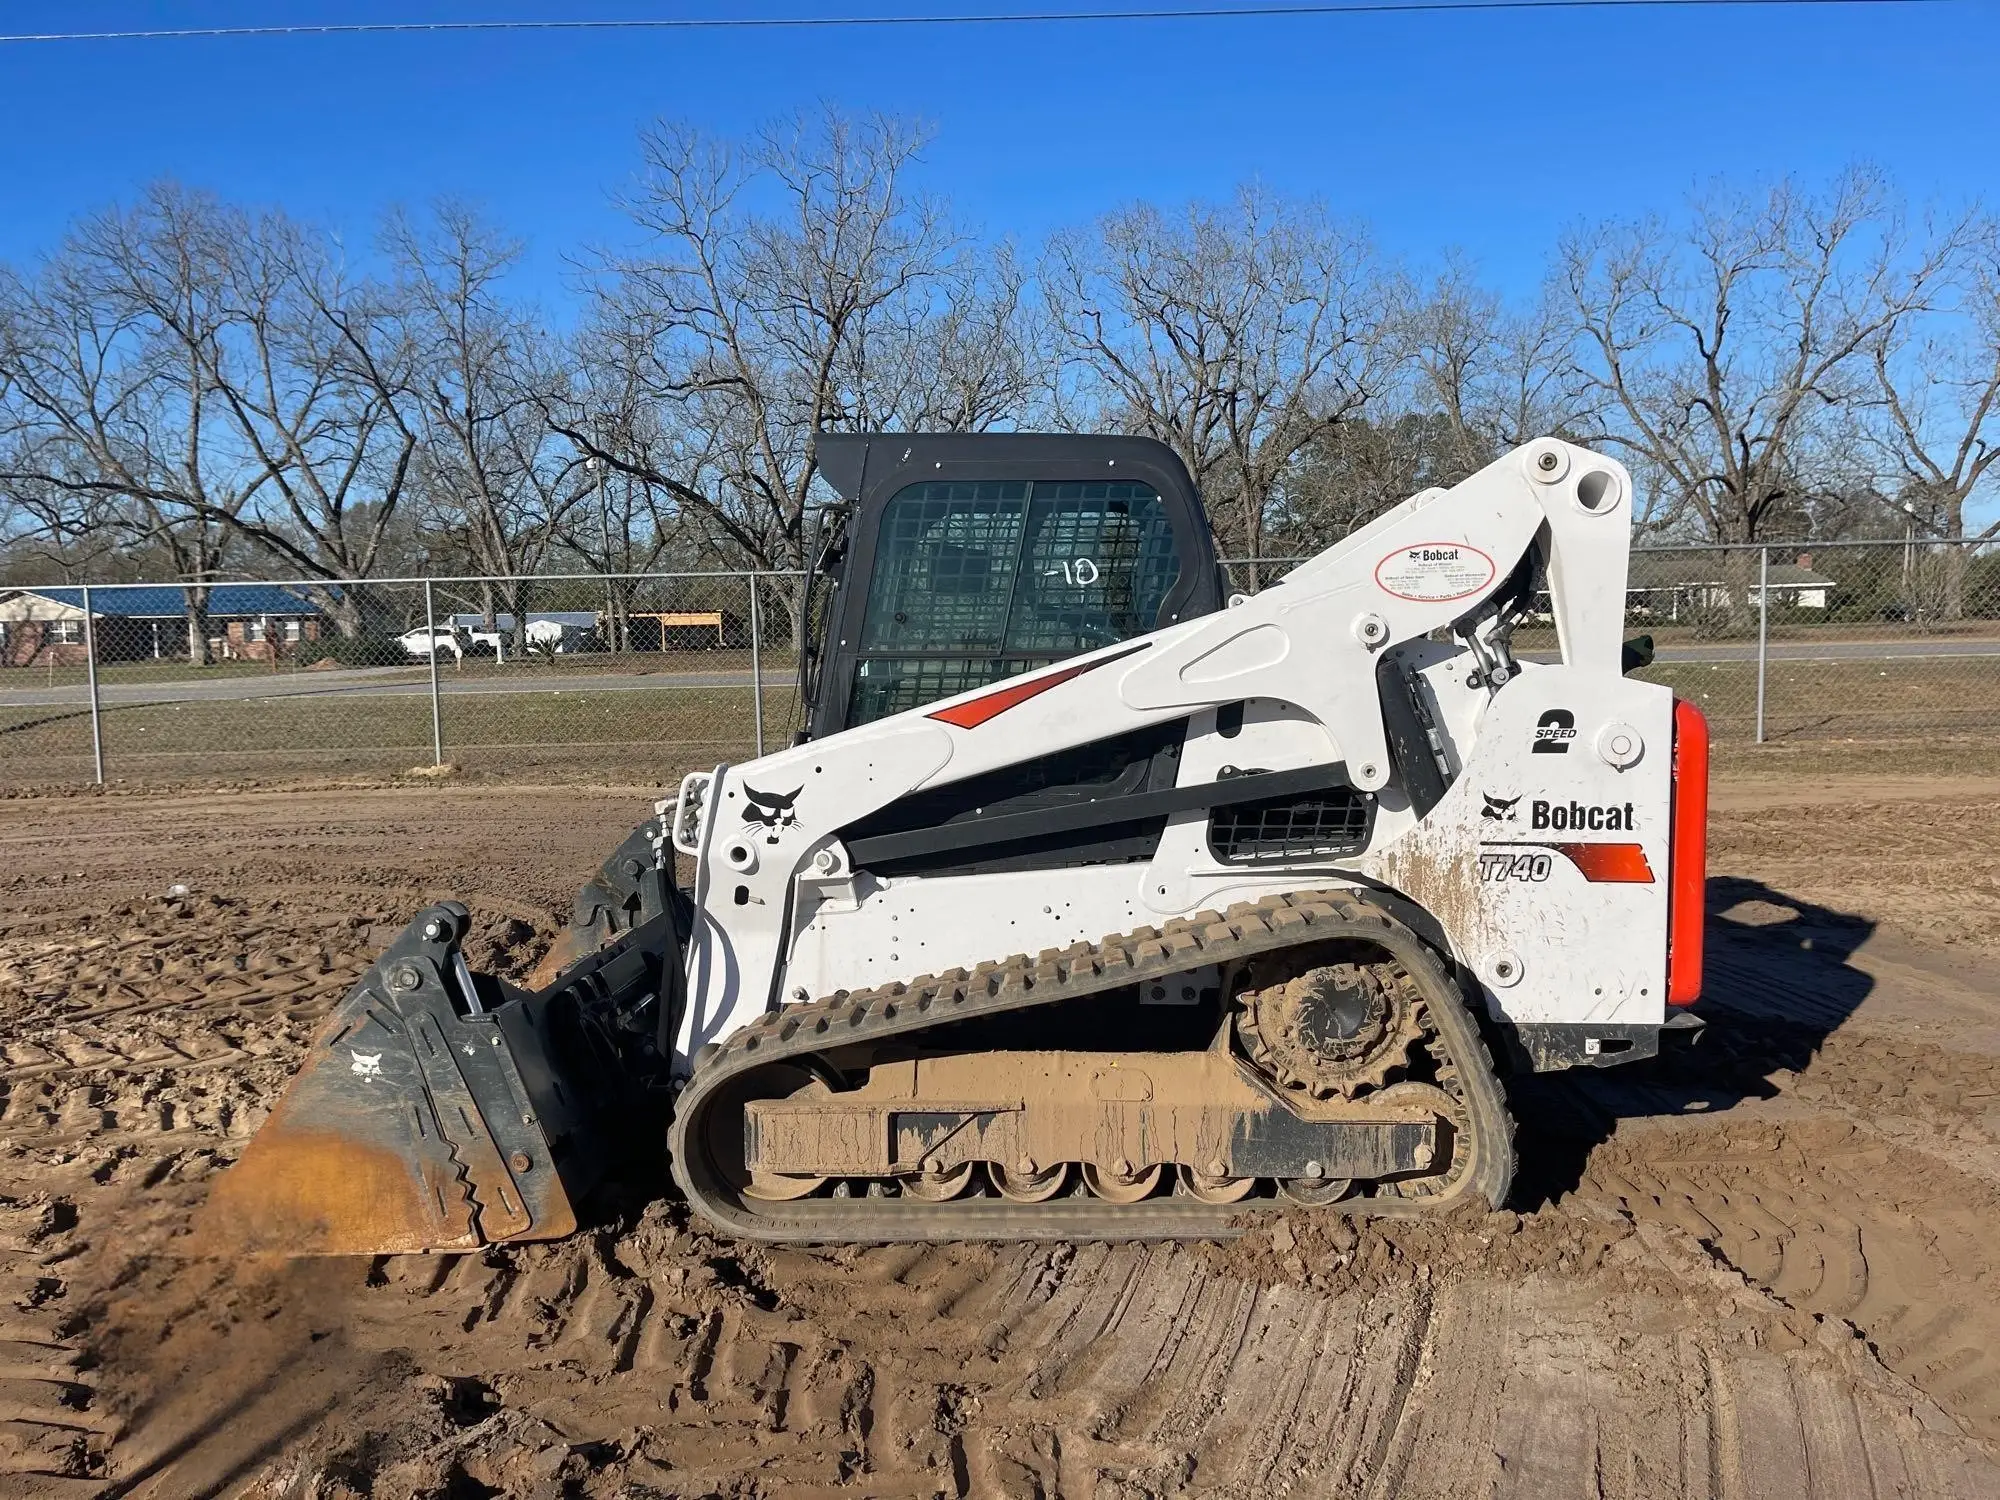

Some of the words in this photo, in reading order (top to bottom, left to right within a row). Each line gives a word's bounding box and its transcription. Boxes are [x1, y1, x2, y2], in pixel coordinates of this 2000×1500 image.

[1423, 549, 1458, 560] Bobcat
[1532, 709, 1574, 753] 2
[1535, 729, 1577, 738] SPEED
[1532, 801, 1634, 830] Bobcat
[1480, 854, 1552, 882] T740
